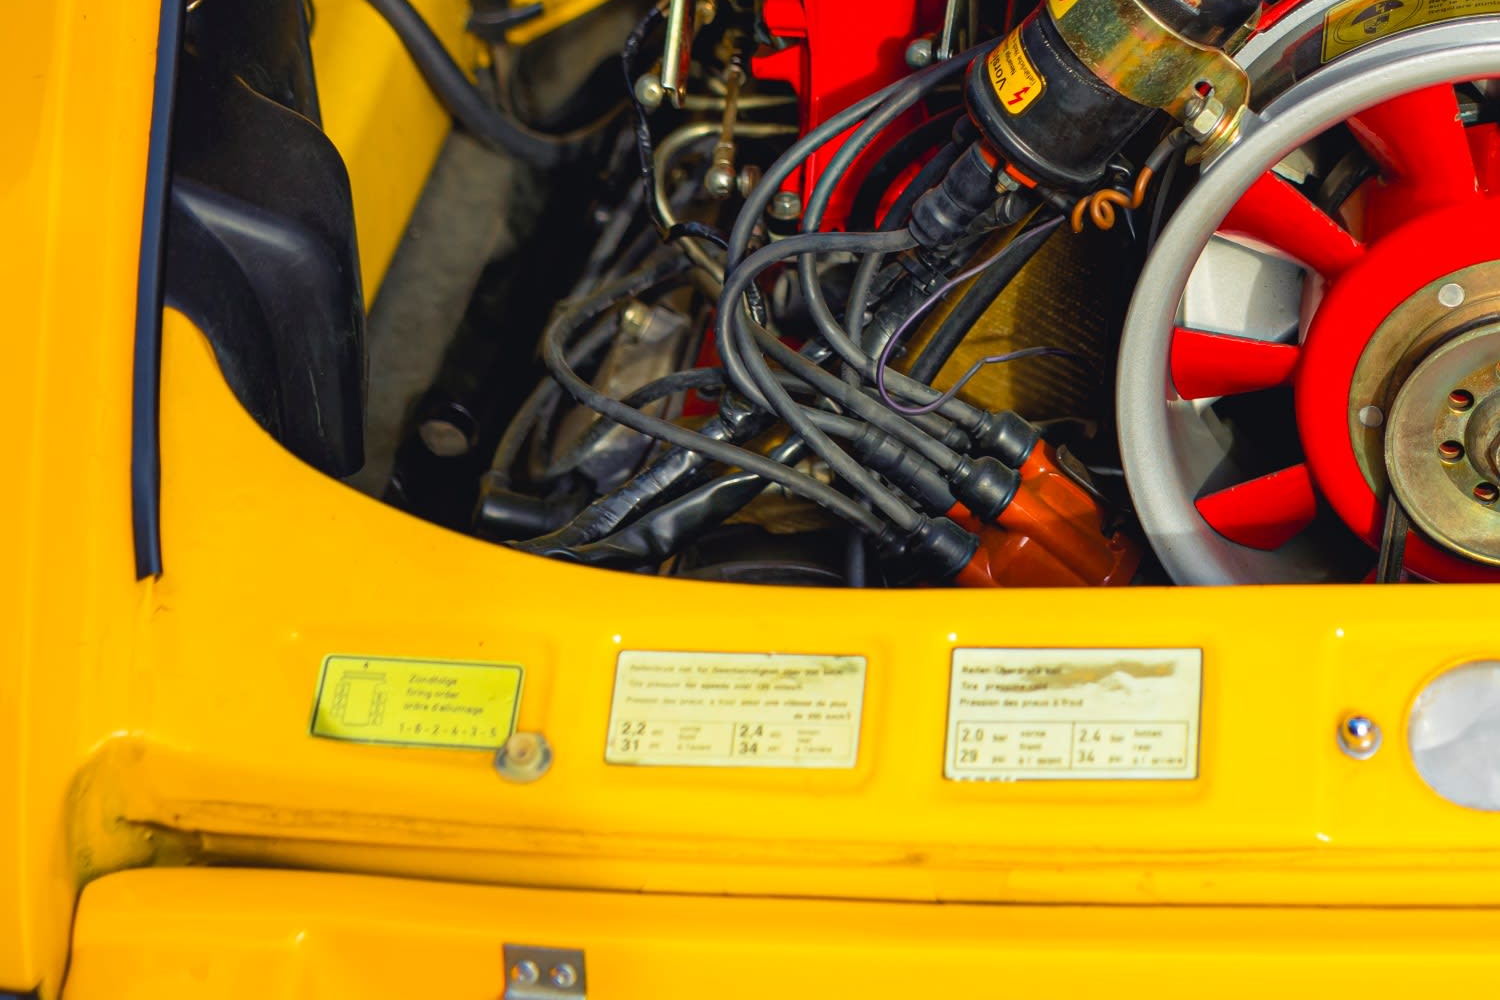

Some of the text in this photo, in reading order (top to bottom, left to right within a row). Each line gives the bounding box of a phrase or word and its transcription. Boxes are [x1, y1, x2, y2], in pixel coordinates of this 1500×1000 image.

[992, 53, 1007, 91] Vorsi
[620, 739, 640, 752] 31
[738, 741, 758, 755] 34
[960, 749, 978, 763] 29
[1077, 750, 1096, 763] 34
